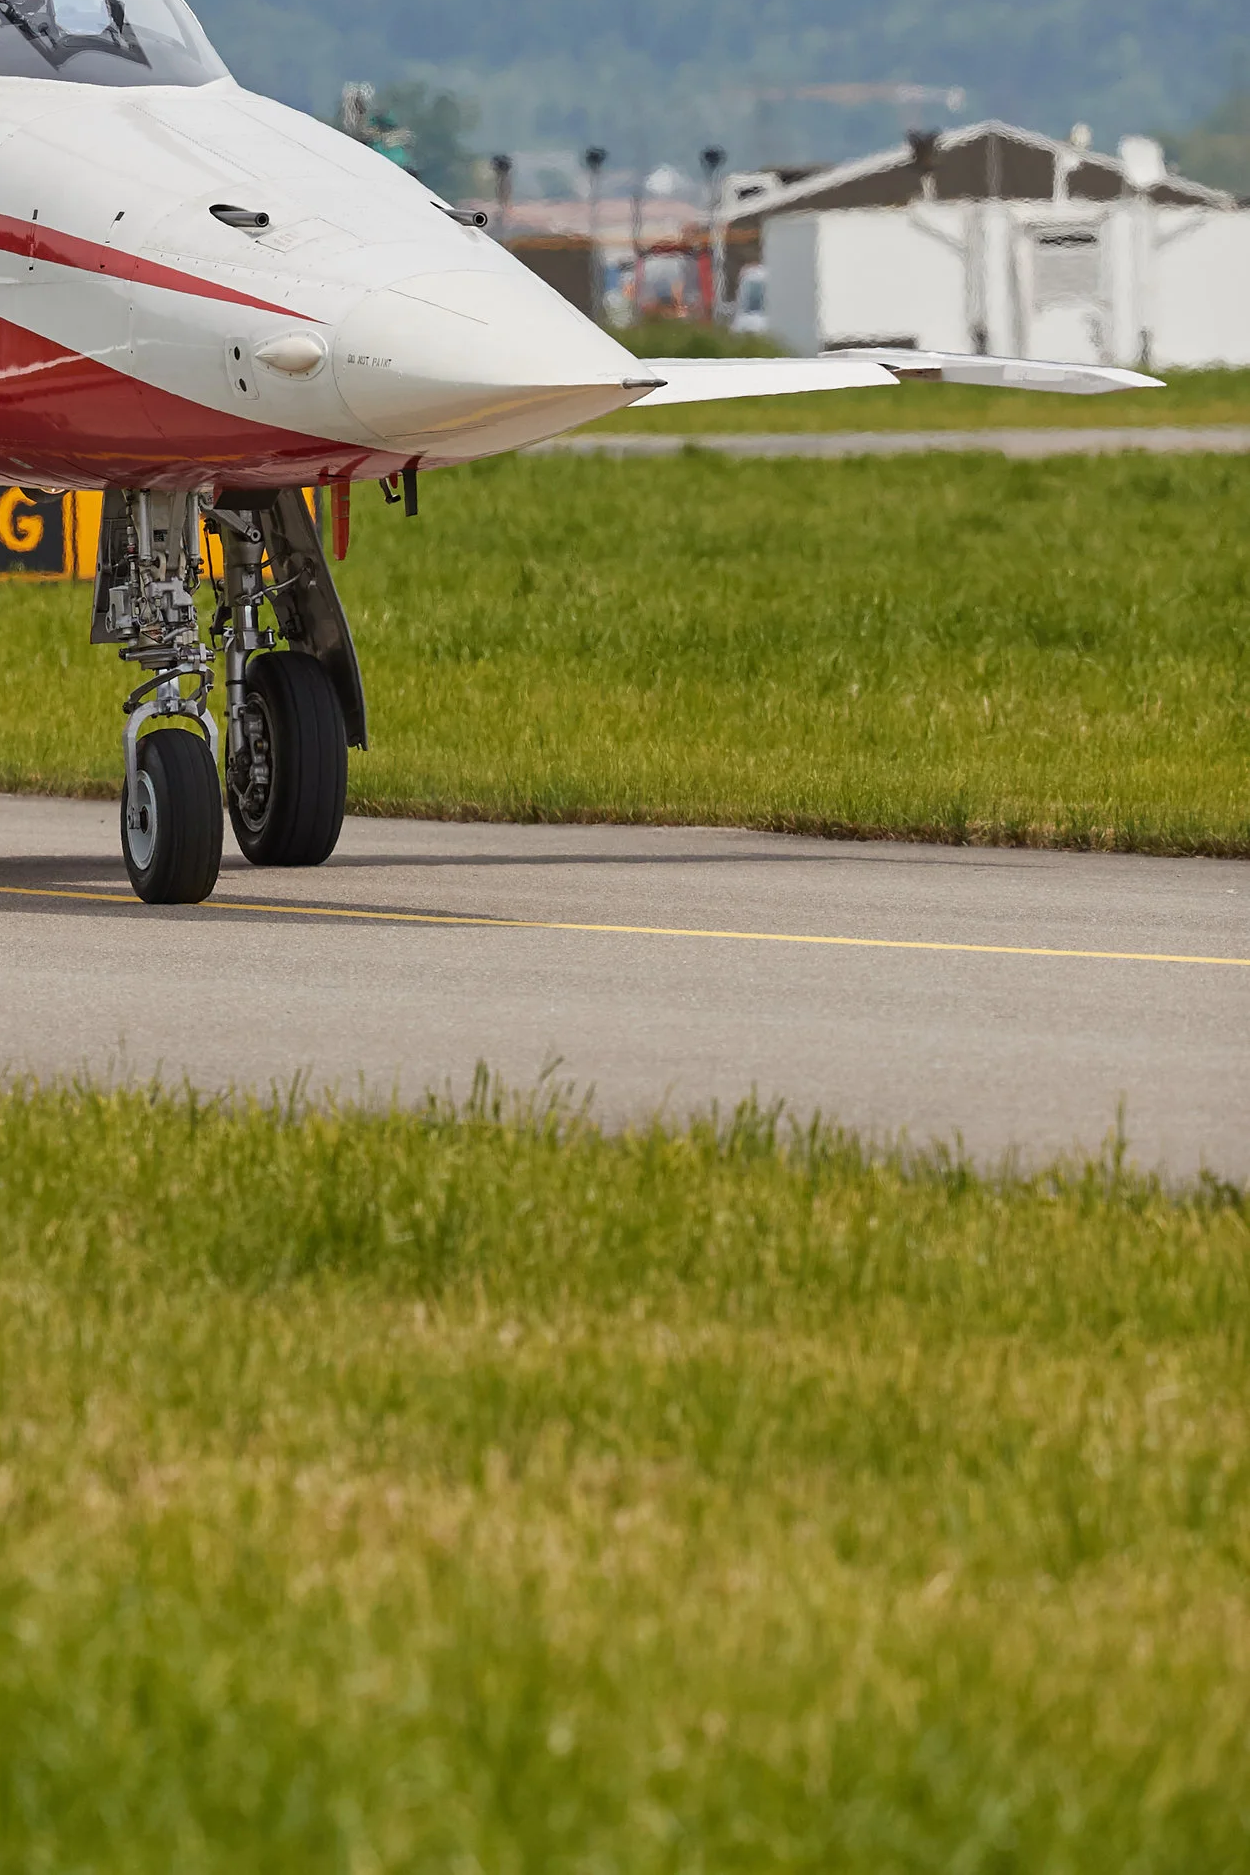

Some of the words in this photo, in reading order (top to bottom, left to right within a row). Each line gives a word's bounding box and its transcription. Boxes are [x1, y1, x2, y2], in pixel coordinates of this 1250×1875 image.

[347, 354, 356, 364] DO
[357, 355, 370, 366] NOT
[371, 357, 392, 367] PAINT
